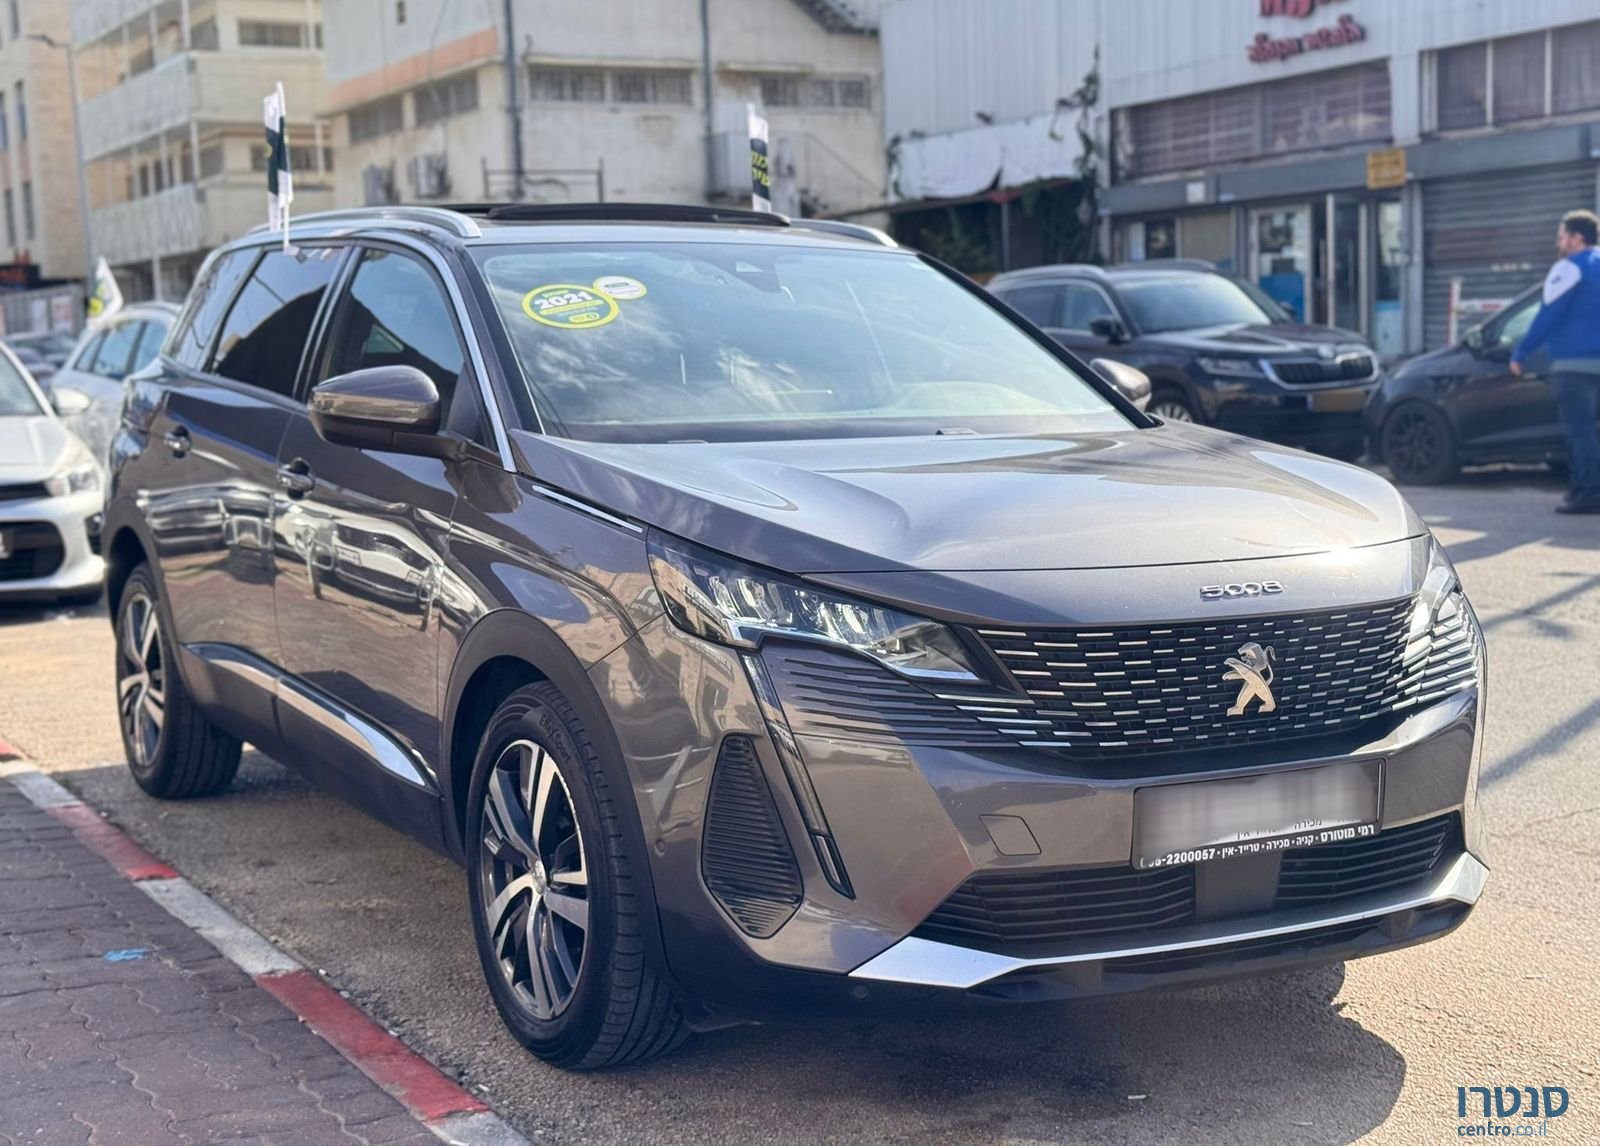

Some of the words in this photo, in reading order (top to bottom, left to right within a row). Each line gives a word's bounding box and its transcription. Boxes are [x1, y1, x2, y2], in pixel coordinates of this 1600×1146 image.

[534, 291, 593, 309] 2021
[1200, 580, 1283, 599] 5008
[1320, 827, 1356, 843] מוטורס
[1357, 824, 1375, 837] רמי
[1266, 838, 1290, 851] מכירה
[1296, 834, 1314, 847] קניה
